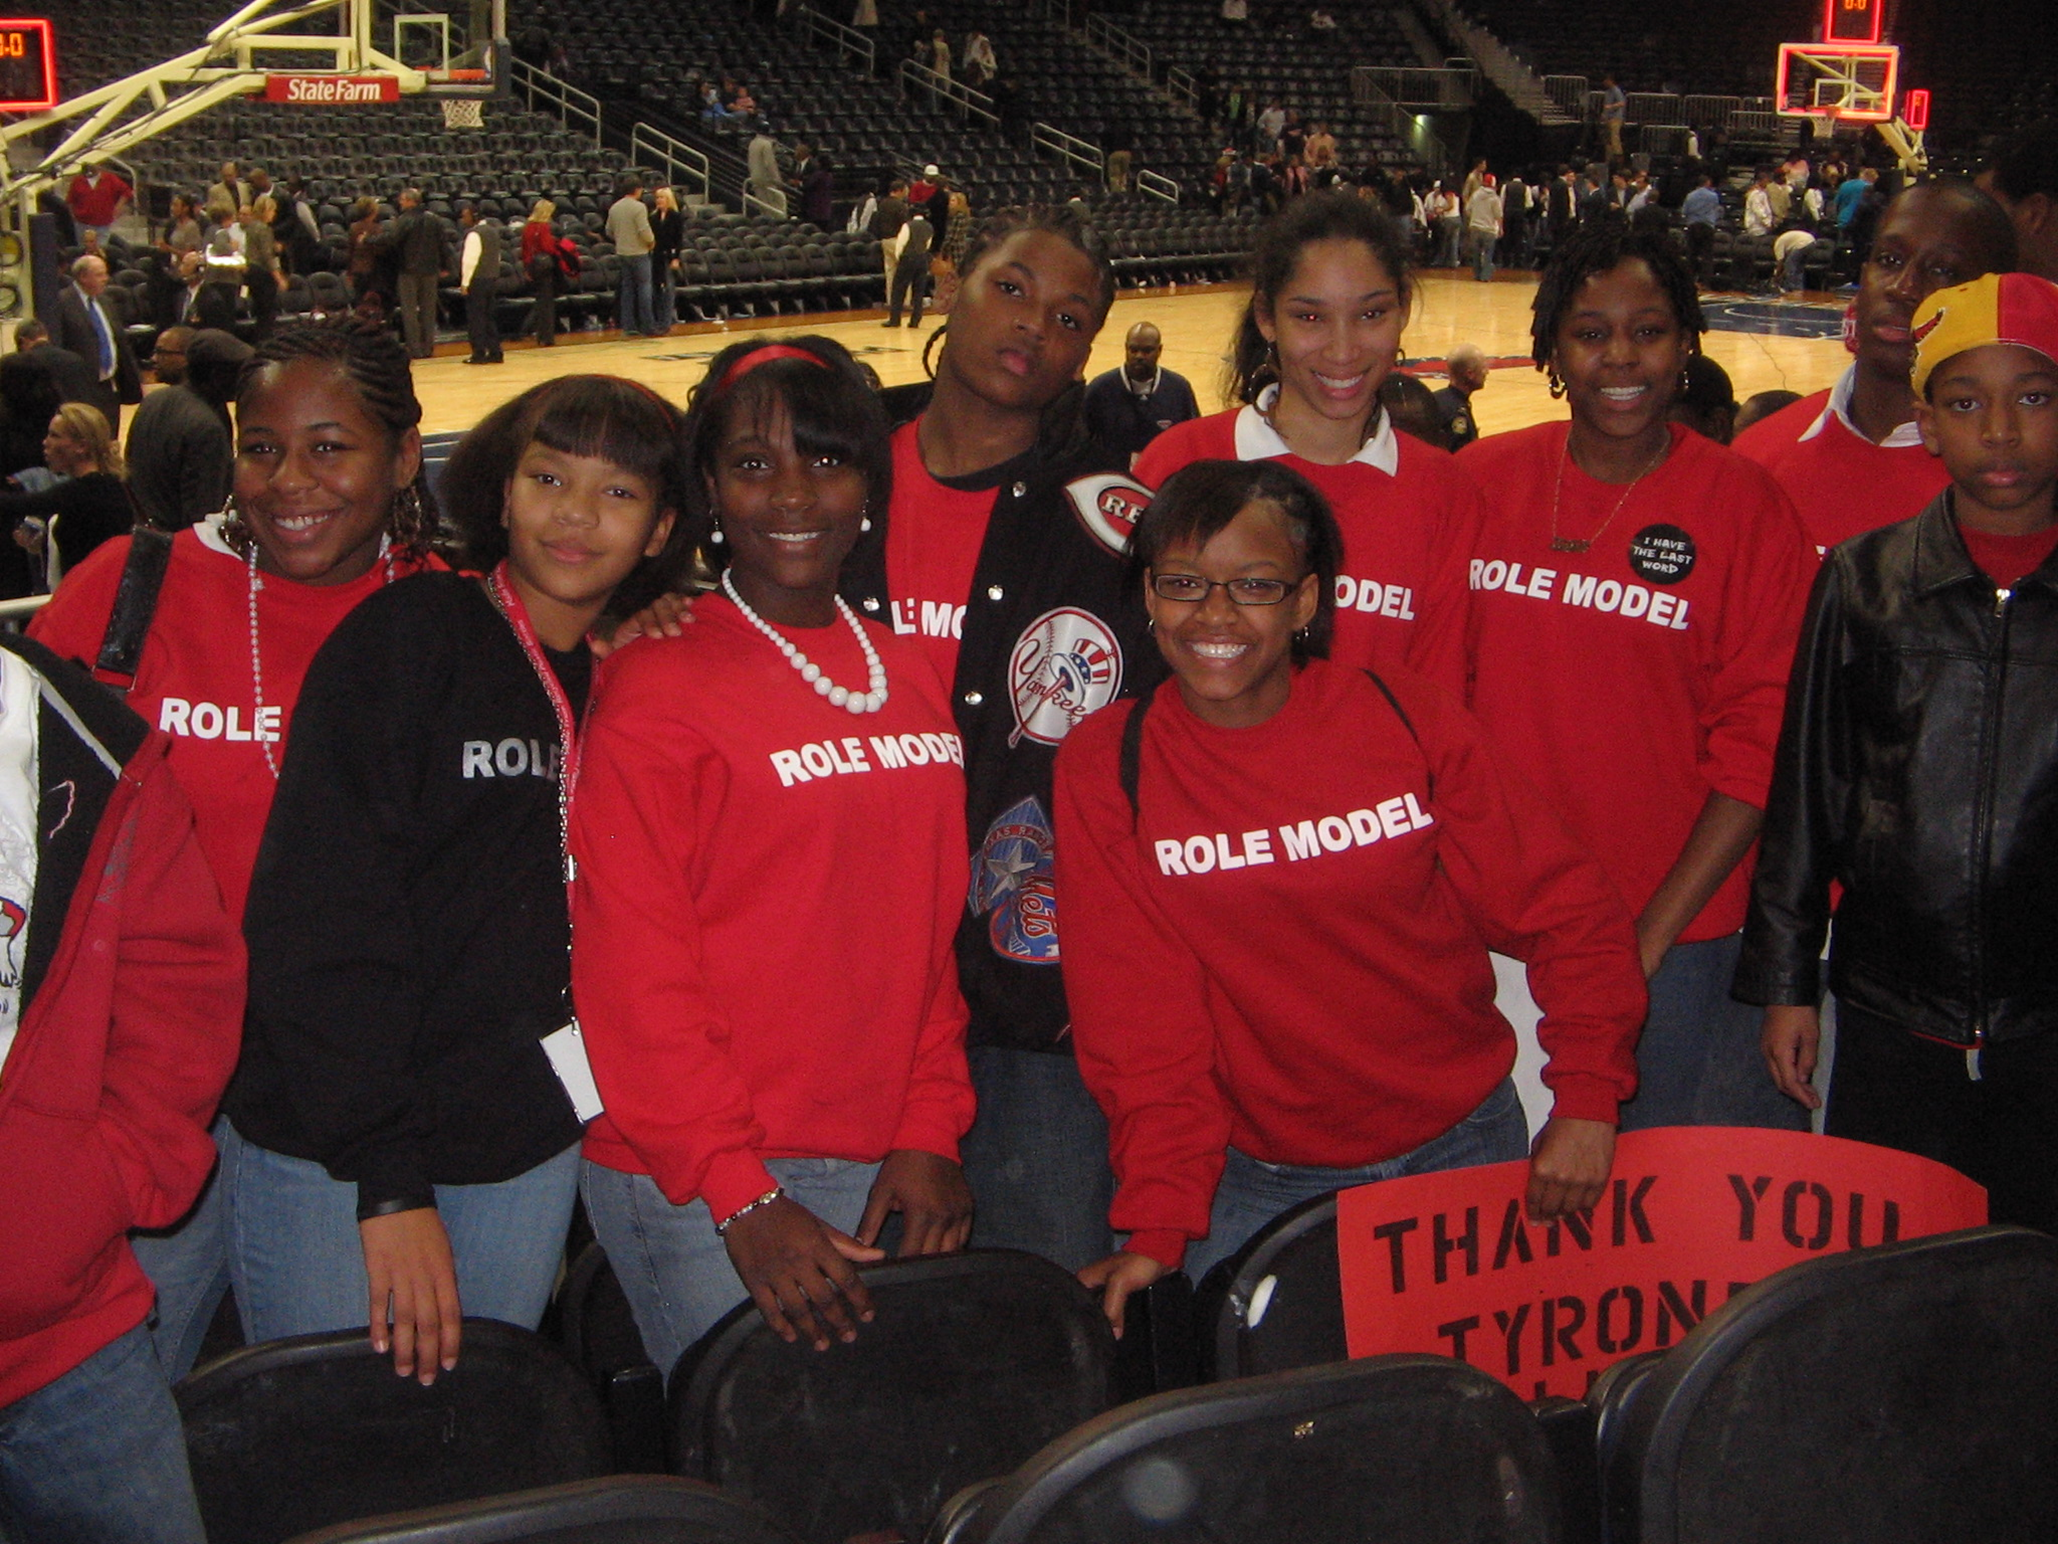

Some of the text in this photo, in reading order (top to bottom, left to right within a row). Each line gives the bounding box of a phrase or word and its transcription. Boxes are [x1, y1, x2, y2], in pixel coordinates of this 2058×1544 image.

[1633, 545, 1693, 565] THE LAST
[1642, 560, 1679, 573] WORD
[1644, 537, 1686, 551] I HAVE
[1334, 574, 1415, 621] ODEL
[1469, 558, 1690, 630] ROLE MODEL
[1015, 638, 1087, 722] Yankee
[159, 697, 282, 742] ROLE
[769, 732, 965, 788] ROLE MODEL
[1154, 792, 1434, 876] ROLE MODEL
[1373, 1173, 1900, 1295] THANK YOU
